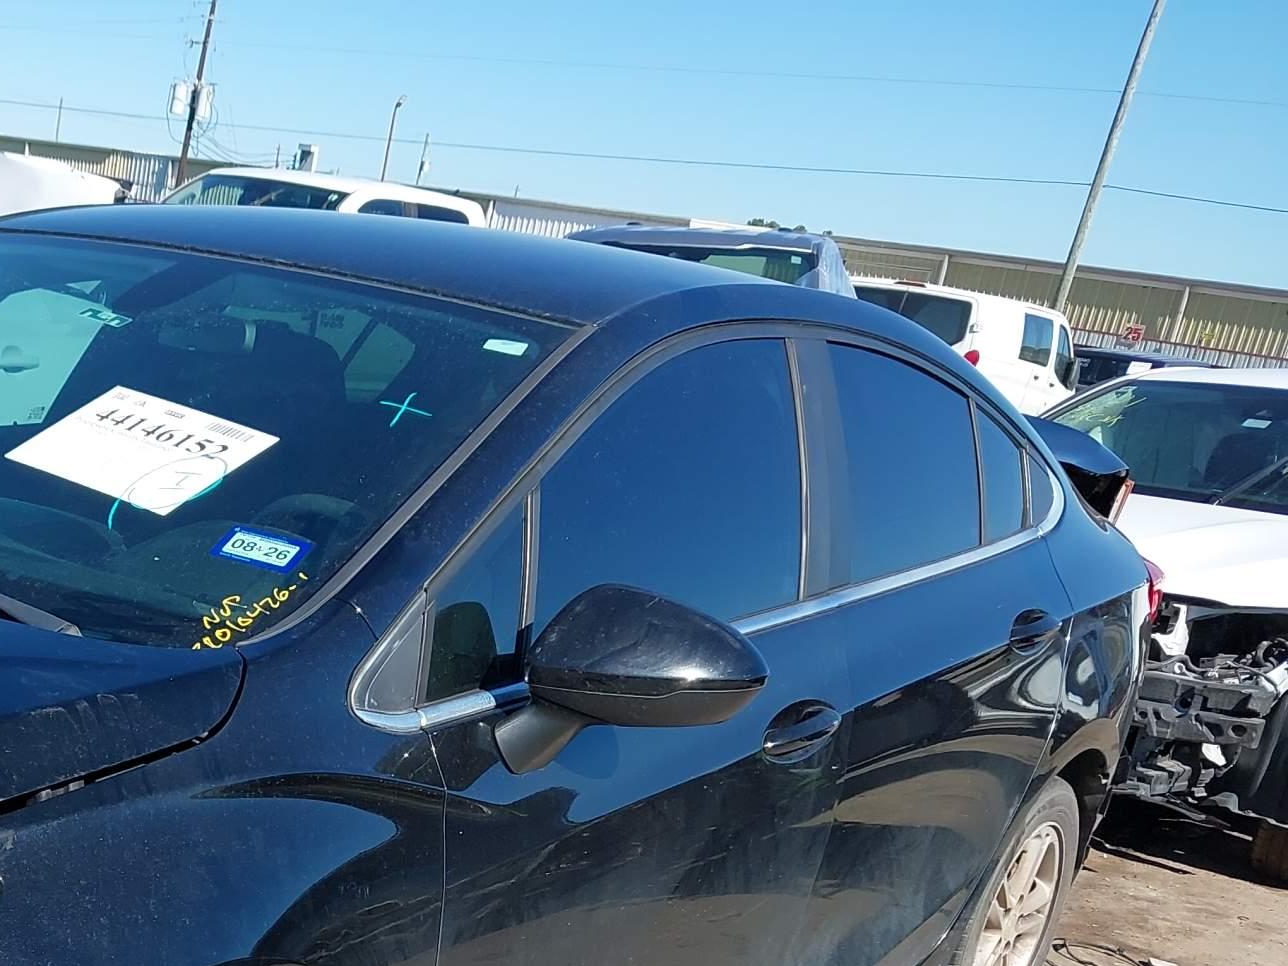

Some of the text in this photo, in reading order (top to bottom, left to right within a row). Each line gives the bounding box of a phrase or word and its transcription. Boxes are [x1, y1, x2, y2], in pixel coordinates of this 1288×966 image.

[1122, 326, 1143, 342] 25
[95, 408, 229, 460] 44146152
[230, 538, 257, 552] 08
[263, 546, 291, 560] 26
